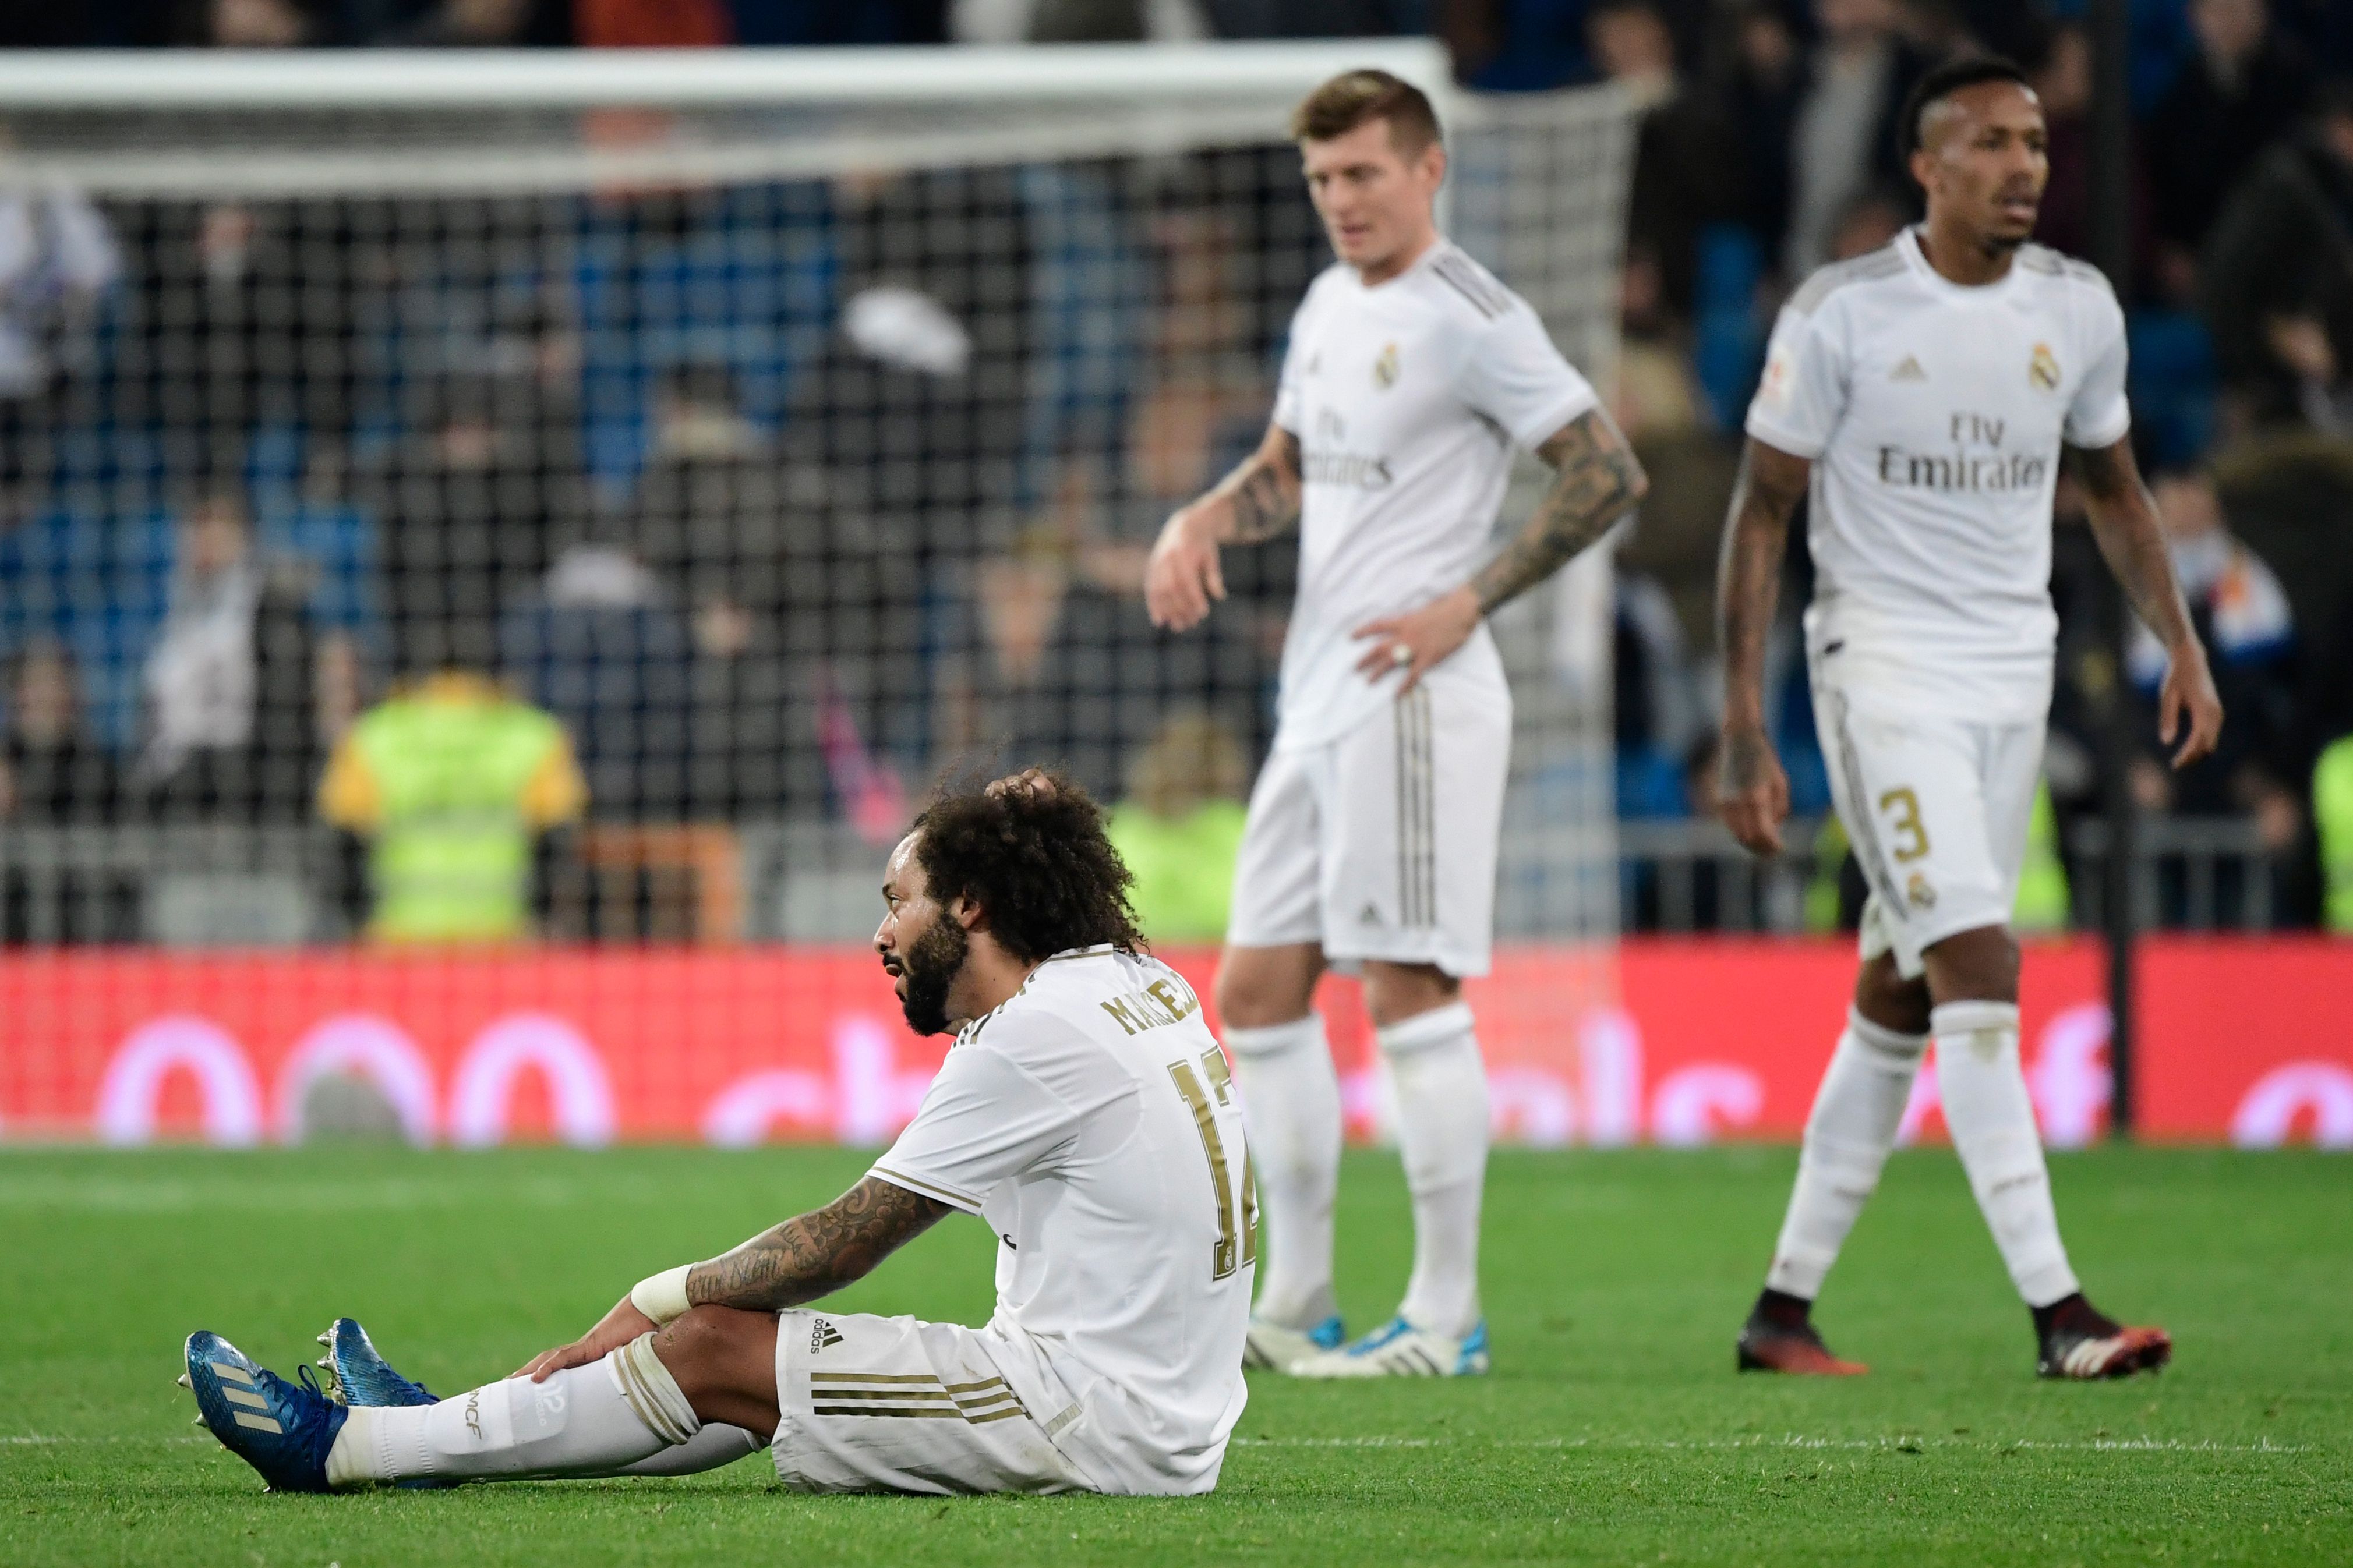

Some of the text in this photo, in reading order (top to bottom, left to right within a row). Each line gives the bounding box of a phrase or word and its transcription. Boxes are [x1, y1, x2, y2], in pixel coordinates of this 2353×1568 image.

[1951, 412, 2004, 448] Fly
[1303, 451, 1393, 491] mirates
[1879, 788, 1930, 864] 3
[810, 1318, 825, 1354] adidas
